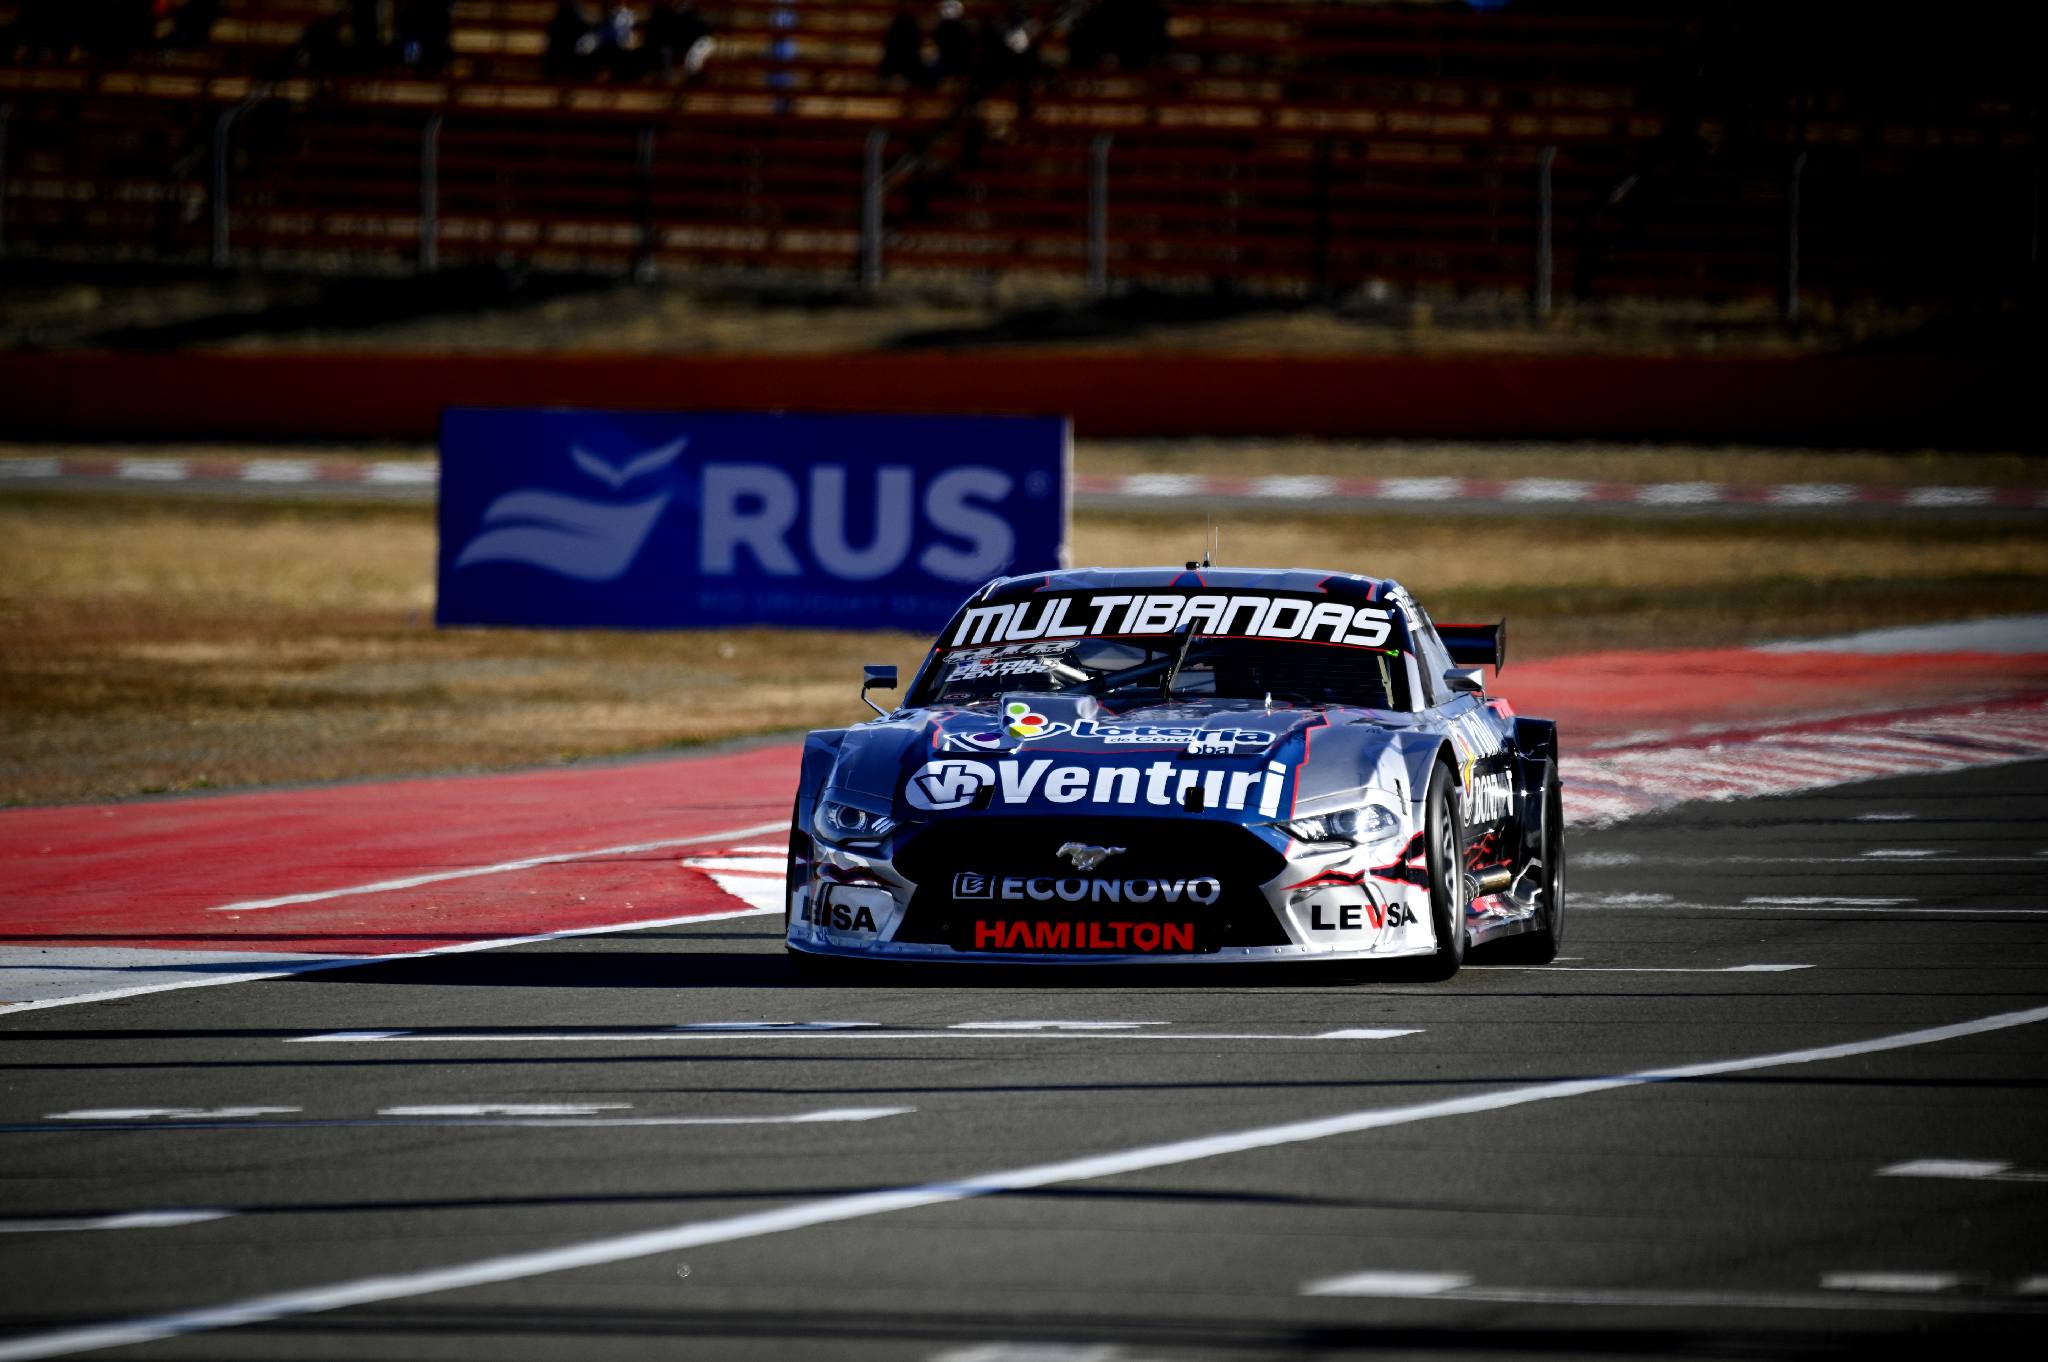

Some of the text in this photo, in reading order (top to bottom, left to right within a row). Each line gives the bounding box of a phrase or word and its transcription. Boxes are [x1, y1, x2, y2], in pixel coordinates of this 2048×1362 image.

[700, 464, 1016, 581] RUS
[952, 595, 1392, 648] MULTIBANDAS
[998, 760, 1287, 818] Venturi
[1001, 876, 1221, 904] ECONOVO
[975, 920, 1194, 951] HAMILTON
[1311, 902, 1418, 931] LEVSA
